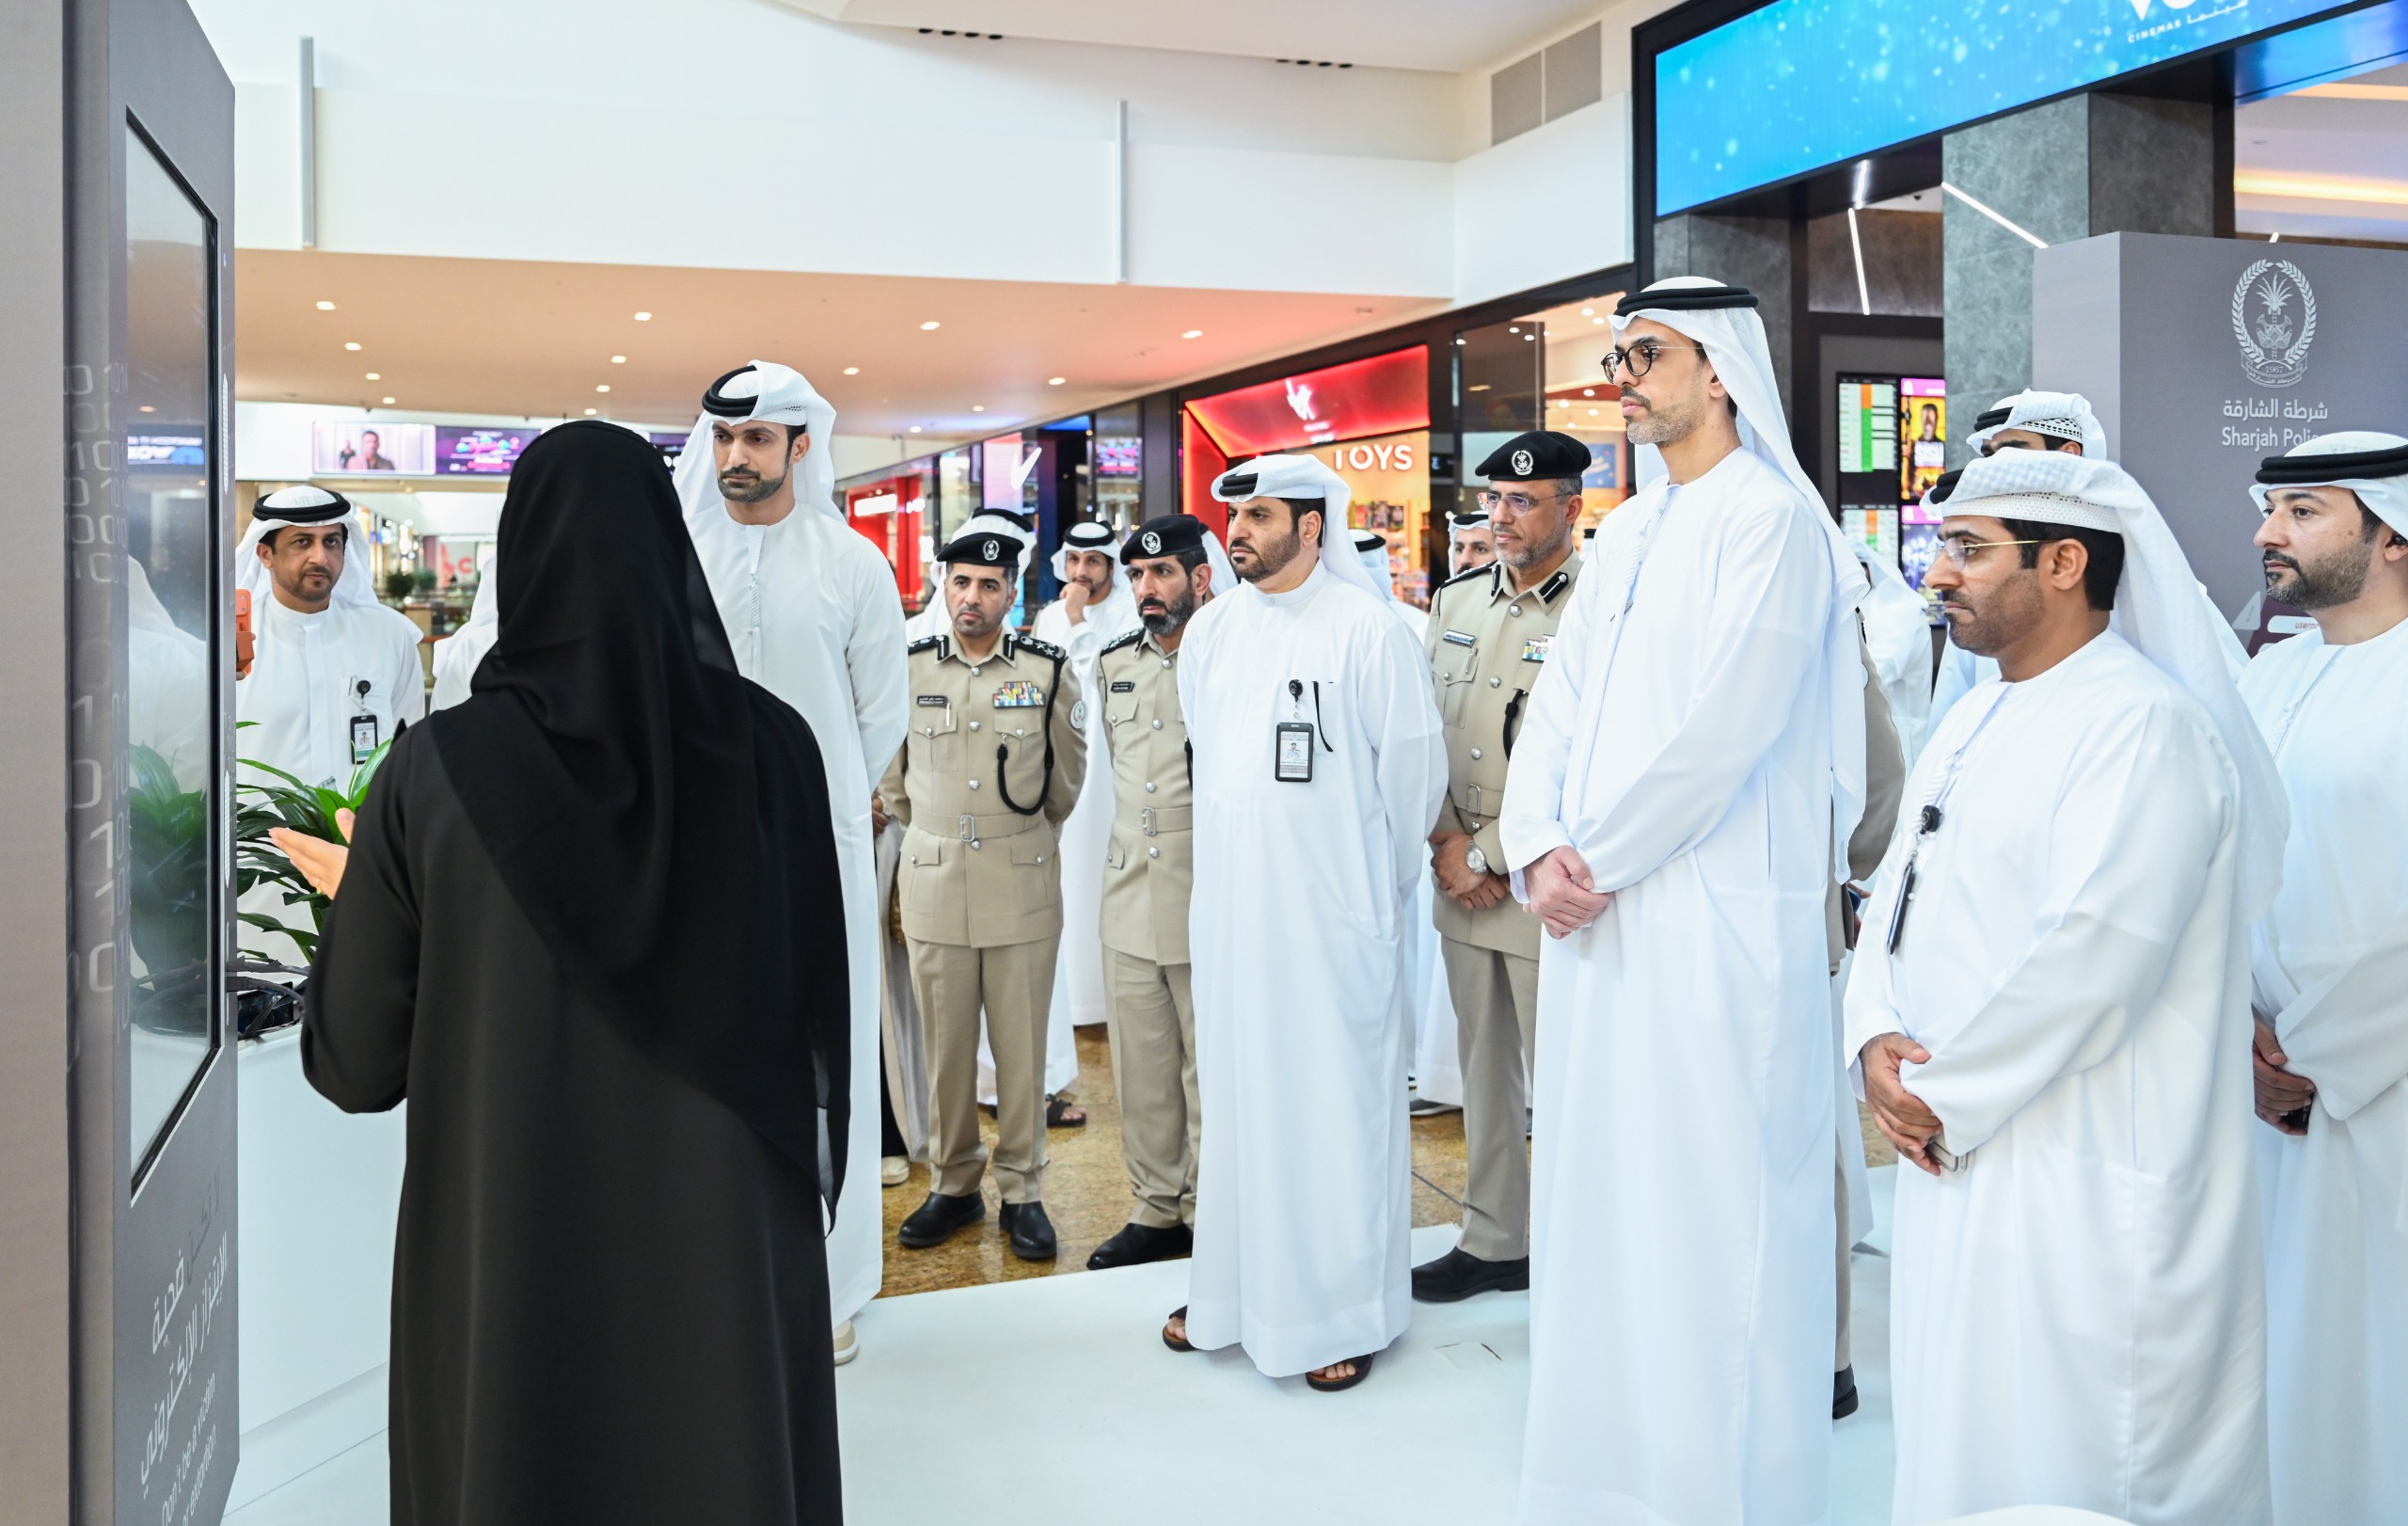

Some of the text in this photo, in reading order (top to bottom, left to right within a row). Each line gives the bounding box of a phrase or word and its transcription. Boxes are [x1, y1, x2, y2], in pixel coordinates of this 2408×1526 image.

[2186, 0, 2249, 24] سينما
[2127, 19, 2182, 43] CINEMAS
[2223, 397, 2329, 422] شرطة الشارقة
[2221, 425, 2322, 453] Sharjah Poli
[152, 1248, 185, 1356] ضحية
[182, 1440, 192, 1483] be
[198, 1372, 215, 1436] victim
[190, 1423, 216, 1517] extortion
